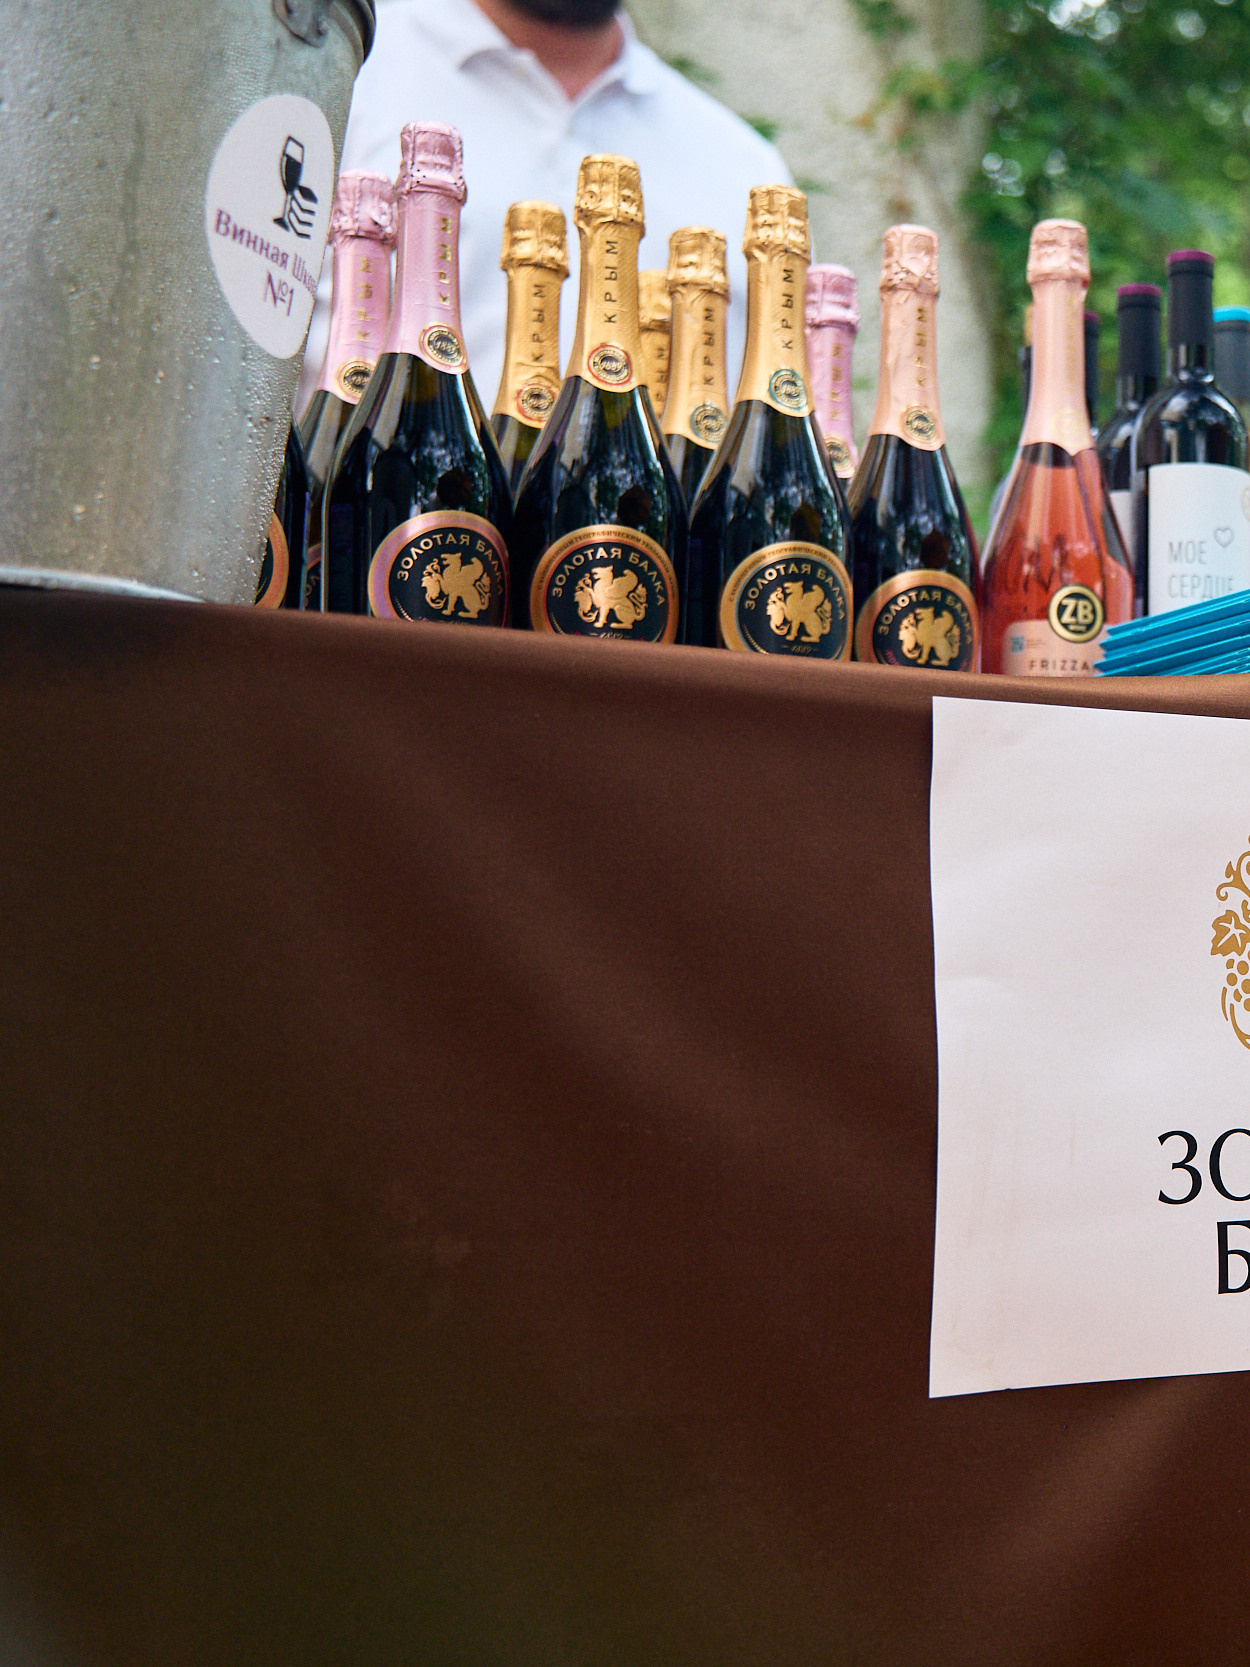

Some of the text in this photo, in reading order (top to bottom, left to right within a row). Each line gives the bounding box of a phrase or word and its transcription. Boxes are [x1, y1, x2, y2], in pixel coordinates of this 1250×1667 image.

[215, 208, 289, 271] Винная
[438, 217, 452, 306] КРЫМ
[263, 271, 294, 317] №1
[356, 257, 373, 341] КРЫМ
[604, 240, 618, 324] КРЫМ
[782, 268, 795, 350] КРЫМ
[532, 284, 546, 361] КРЫМ
[703, 307, 716, 386] КРЫМ
[915, 307, 928, 387] КРЫМ
[397, 532, 471, 582] ЗОЛОТАЯ
[574, 530, 641, 545] ГЕОГРАФИЧЕСКИМ
[1168, 540, 1208, 565] МОЕ
[552, 547, 623, 598] ЗОЛОТАЯ
[628, 552, 666, 606] БАЛКА
[745, 563, 812, 611] ЗОЛОТАЯ
[816, 568, 846, 620] БАЛКА
[878, 590, 973, 645] ЗОЛОТАЯ БАЛКА
[1060, 598, 1095, 625] ZB
[1029, 660, 1095, 671] FRIZZA
